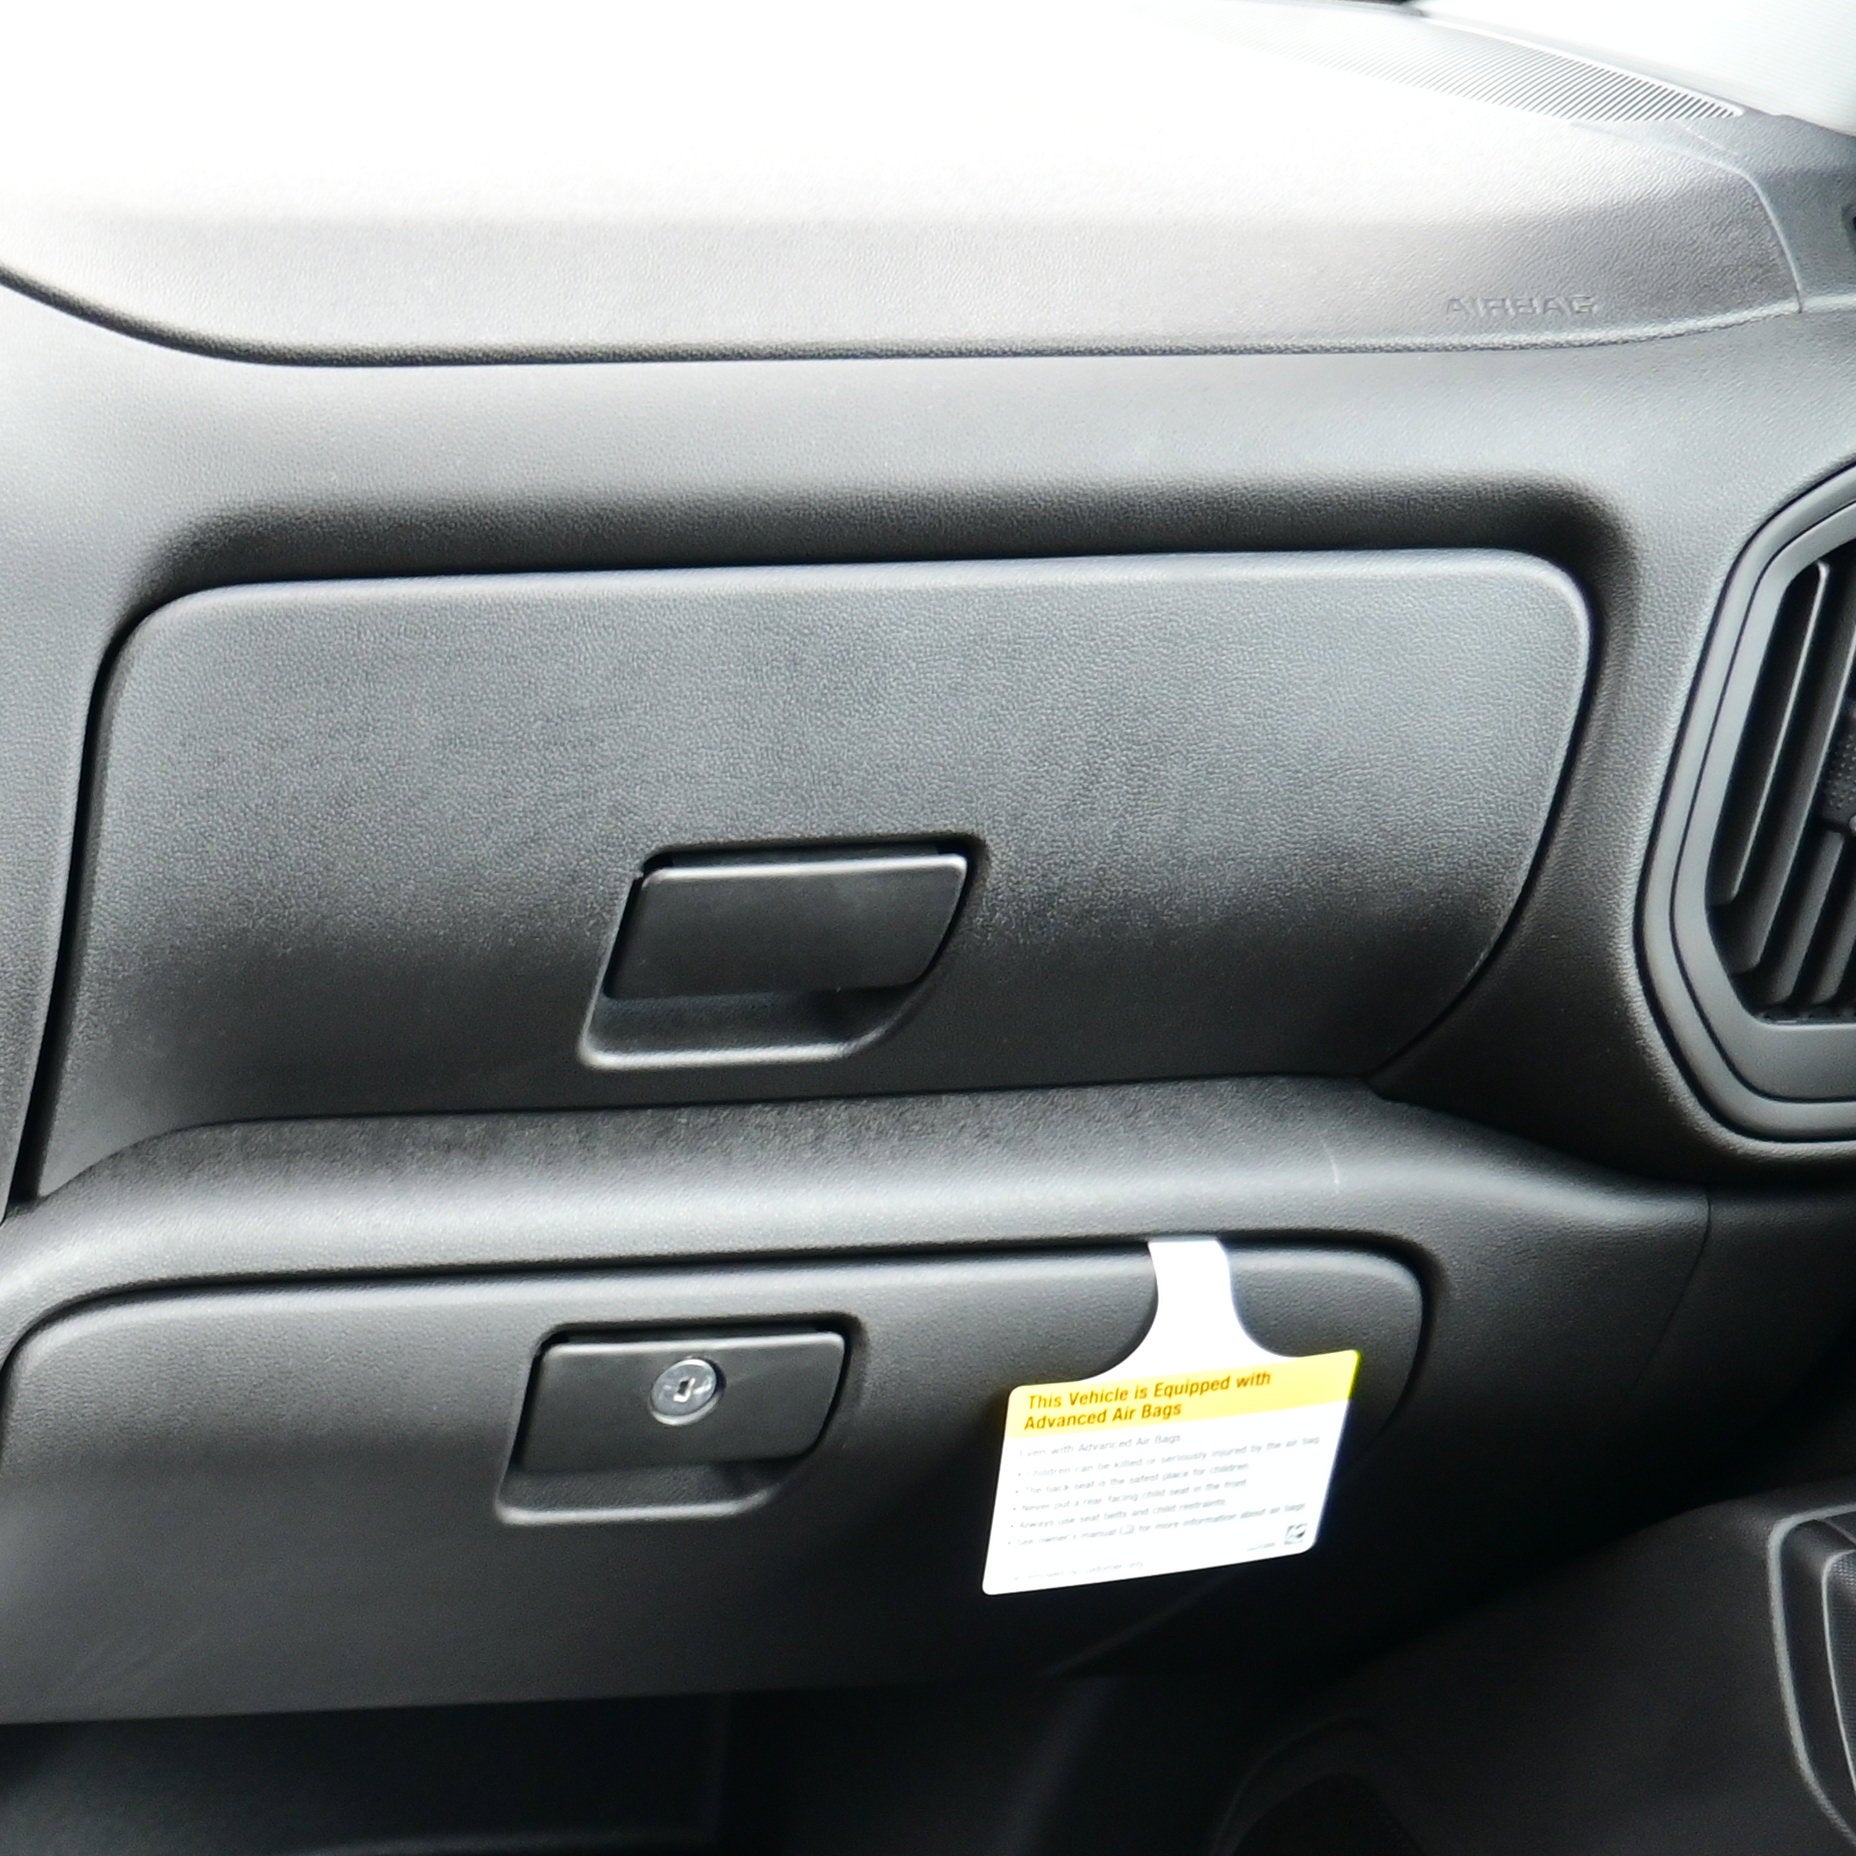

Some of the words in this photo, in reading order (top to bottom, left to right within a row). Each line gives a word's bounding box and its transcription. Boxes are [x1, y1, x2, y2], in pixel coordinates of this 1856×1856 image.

[1444, 295, 1599, 317] AIRBAG
[1028, 1394, 1063, 1411] This
[1068, 1387, 1129, 1406] Vehicle
[1134, 1384, 1149, 1400] is
[1153, 1375, 1232, 1399] Equipped
[1236, 1371, 1272, 1388] with
[1024, 1409, 1108, 1431] Advanced
[1112, 1405, 1136, 1422] Air
[1141, 1401, 1183, 1420] Bags
